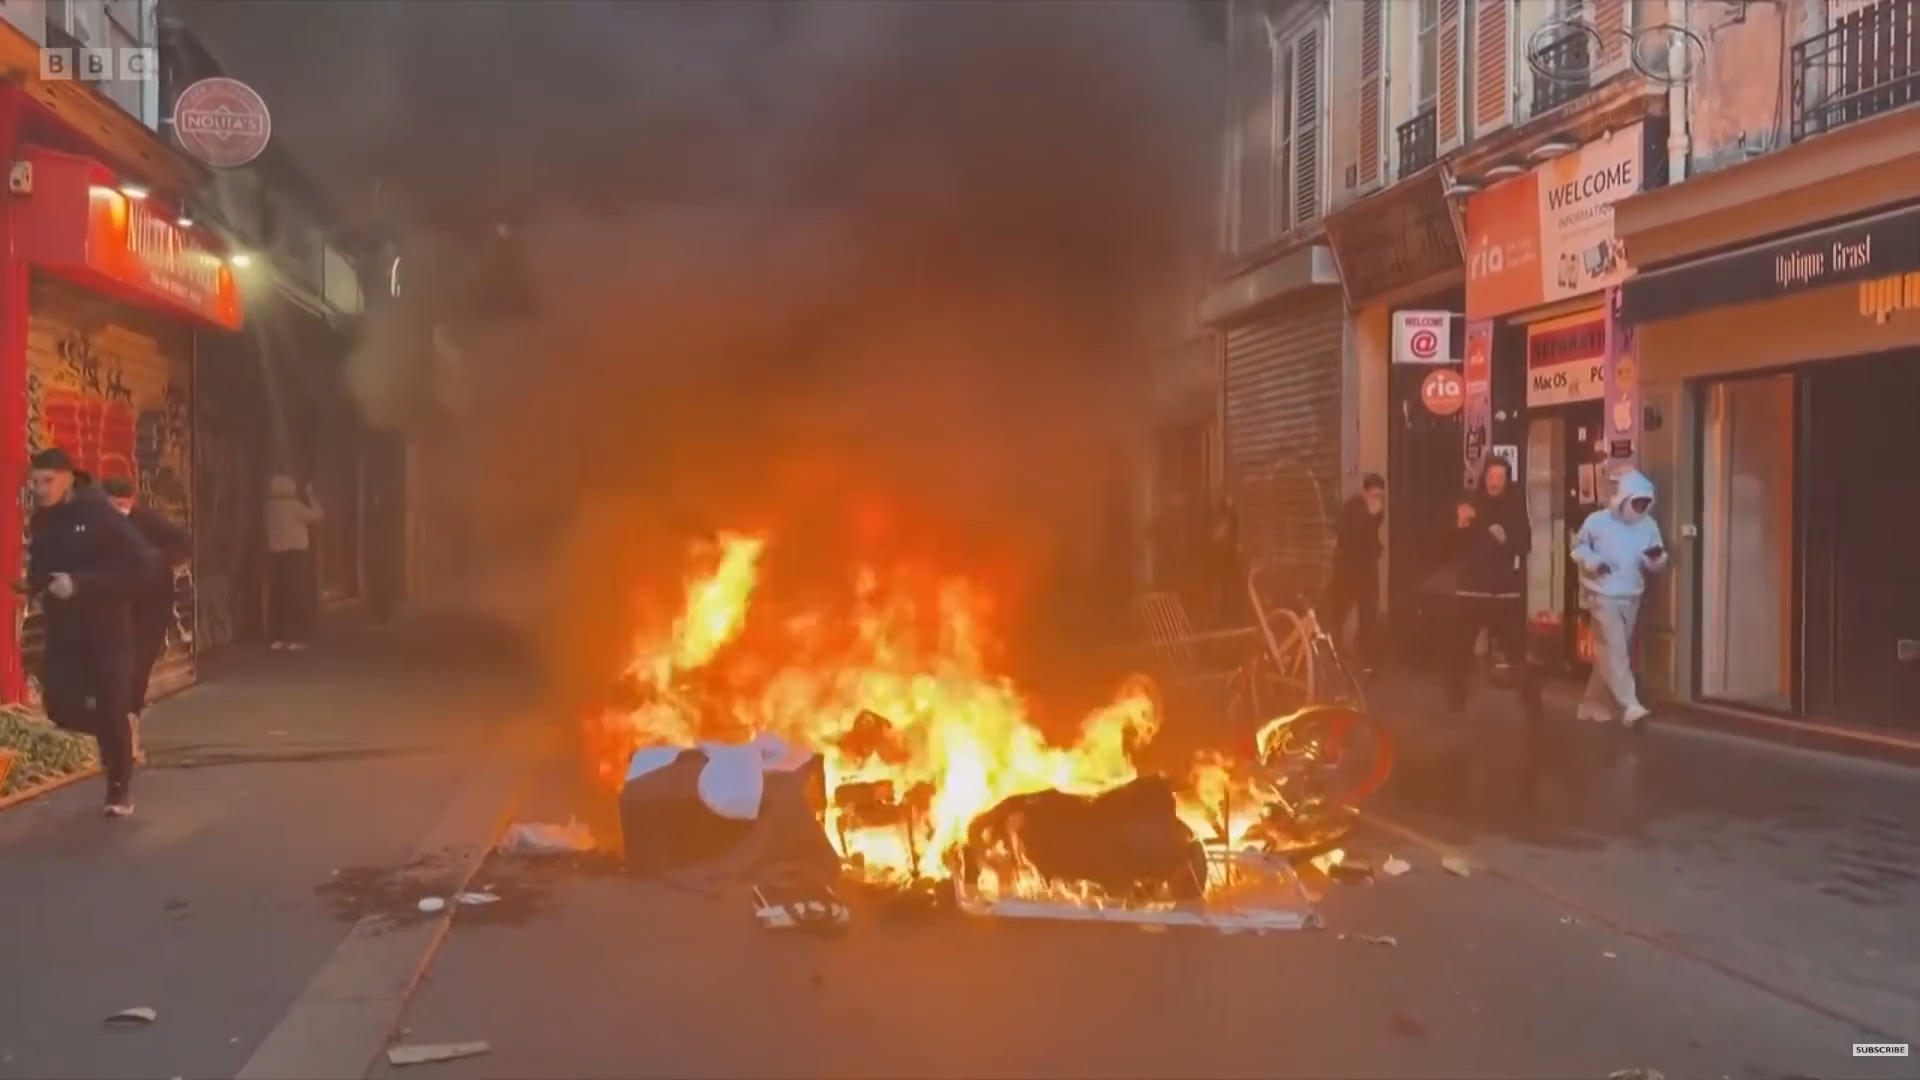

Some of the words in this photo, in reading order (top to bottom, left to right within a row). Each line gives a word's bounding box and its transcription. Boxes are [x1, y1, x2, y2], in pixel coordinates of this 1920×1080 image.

[1548, 159, 1632, 210] WELCOME
[1471, 235, 1503, 280] ria
[1405, 317, 1443, 327] WELCOME
[1426, 374, 1460, 397] ria
